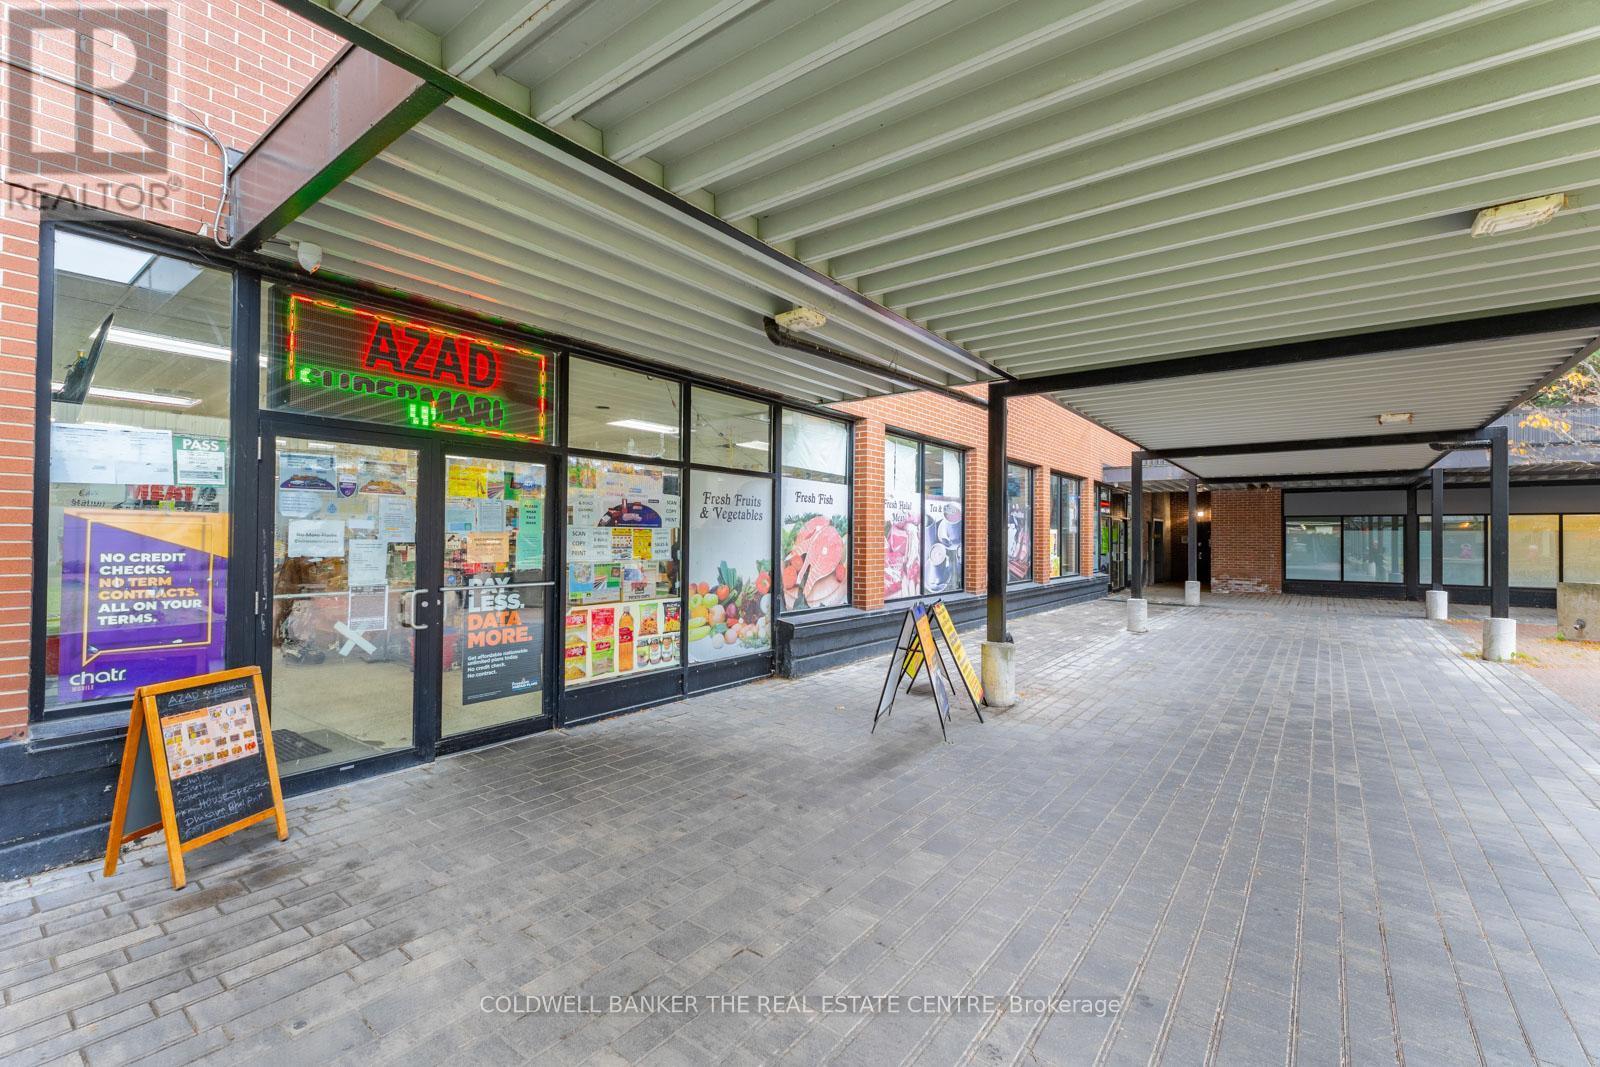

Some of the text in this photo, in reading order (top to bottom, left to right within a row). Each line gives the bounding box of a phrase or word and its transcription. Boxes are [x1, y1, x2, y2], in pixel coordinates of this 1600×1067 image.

[364, 319, 498, 390] AZAD
[182, 439, 219, 451] PASS
[703, 491, 762, 507] Fresh Fruits
[794, 491, 834, 505] Fresh Fish
[700, 506, 763, 522] & Vegetables
[100, 552, 186, 563] NO CREDIT
[100, 565, 170, 575] CHECKS.
[99, 576, 172, 588] NO TERM
[468, 577, 510, 594] PAY
[98, 587, 199, 601] CONTRACTS.
[98, 599, 202, 613] ALL ON YOUR
[468, 593, 525, 613] LESS.
[97, 613, 157, 626] TERMS.
[467, 610, 522, 631] DATA
[467, 626, 533, 649] MORE.
[69, 668, 127, 686] chatr
[168, 691, 199, 705] AZAD
